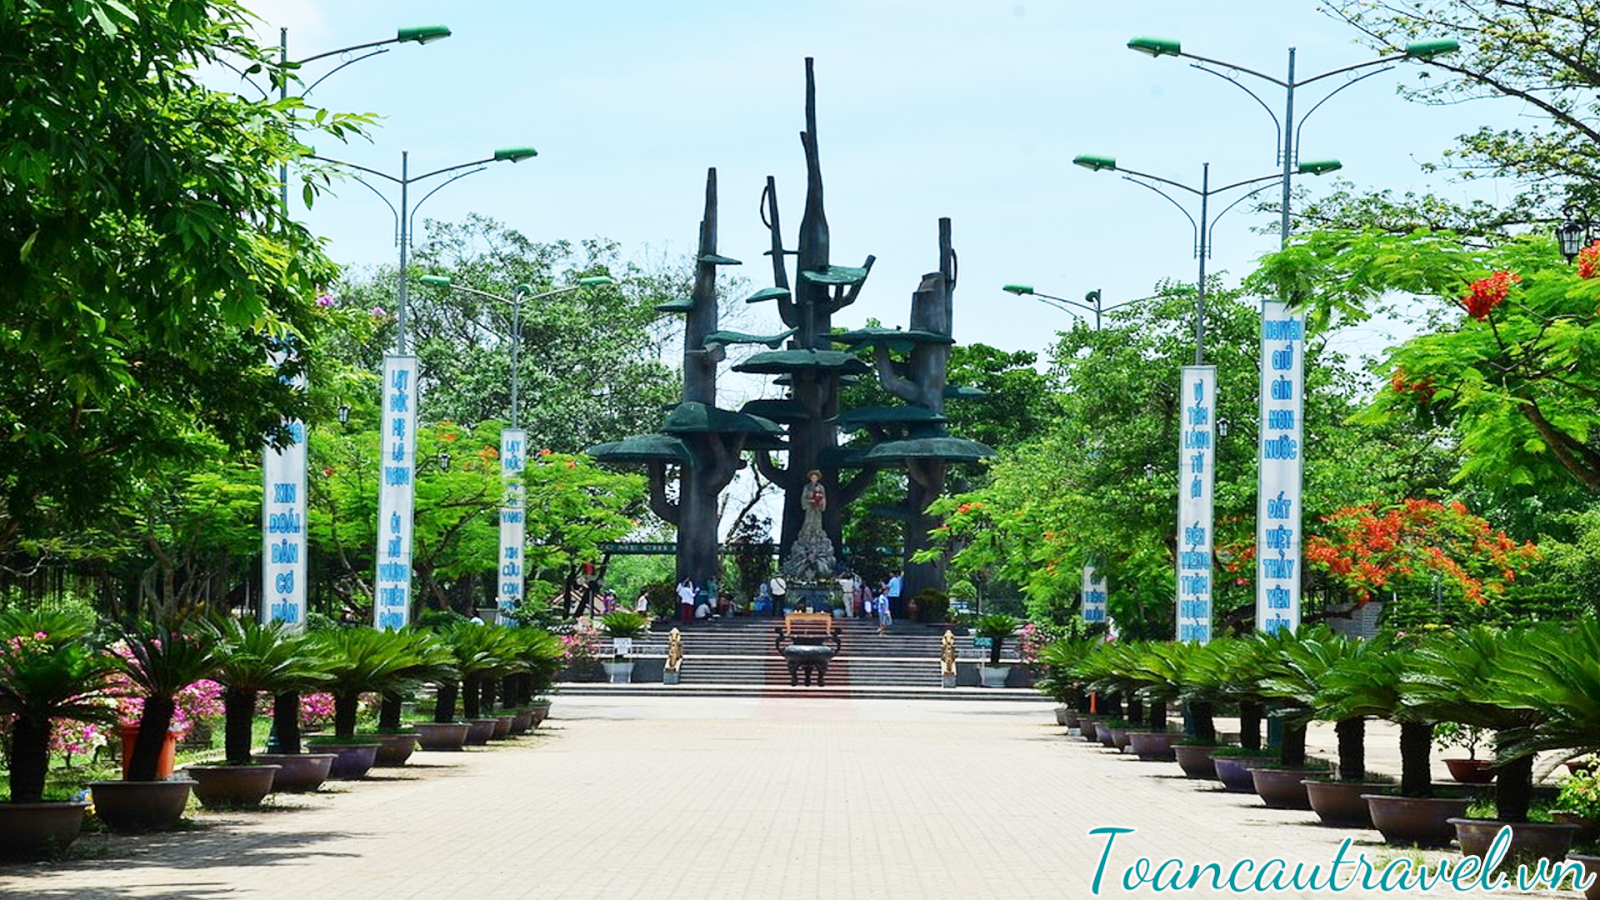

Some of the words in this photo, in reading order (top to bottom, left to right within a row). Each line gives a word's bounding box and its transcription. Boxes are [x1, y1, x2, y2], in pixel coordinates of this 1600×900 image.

[1271, 374, 1293, 400] GÌN
[1269, 409, 1294, 430] NON
[1185, 426, 1211, 449] LÒNG
[273, 483, 297, 503] XIN
[275, 569, 294, 594] CƠ
[1265, 584, 1291, 609] YÊN
